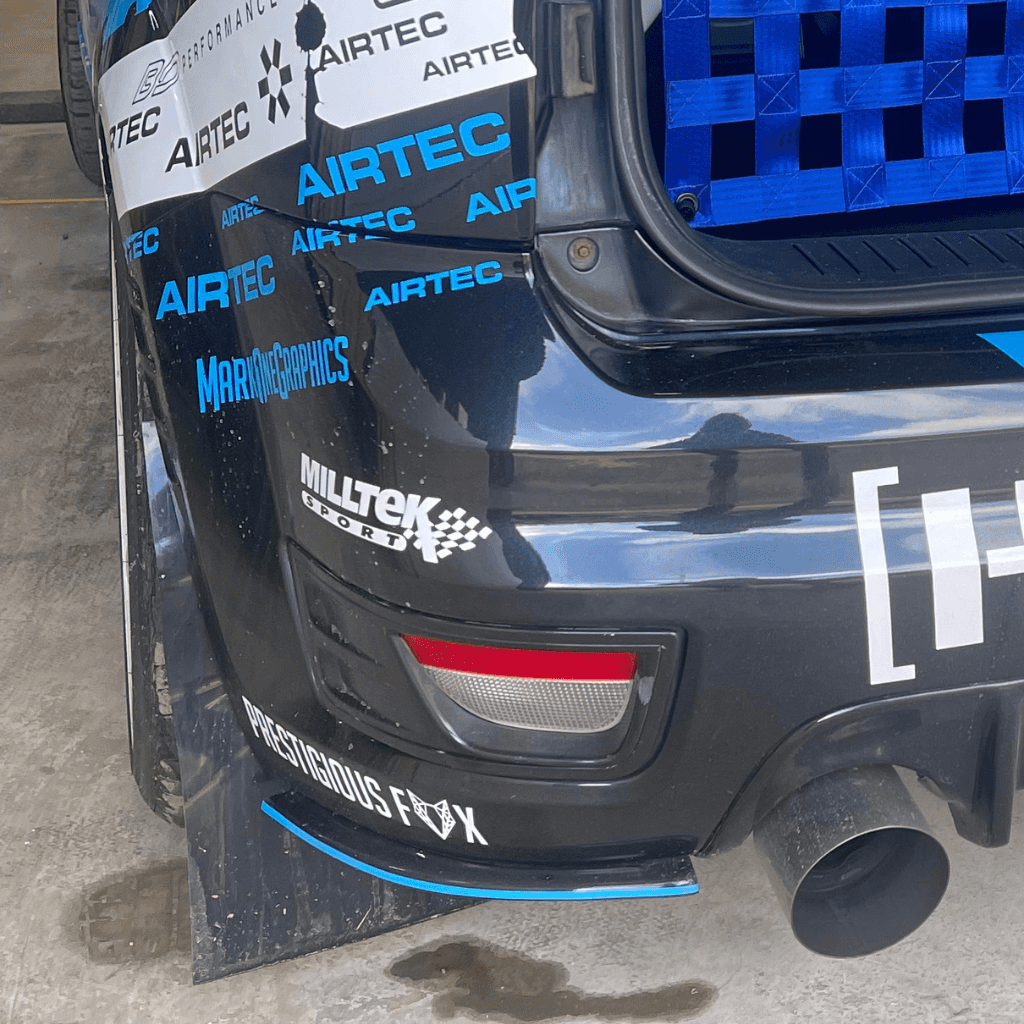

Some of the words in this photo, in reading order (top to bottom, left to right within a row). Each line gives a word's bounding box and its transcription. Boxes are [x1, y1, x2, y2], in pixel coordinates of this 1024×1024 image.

[319, 11, 448, 68] AIRTEC
[164, 101, 251, 173] AIRTEC
[297, 112, 512, 206] AIRTEC
[155, 254, 276, 321] AIRTEC
[364, 260, 503, 312] AIRTEC
[305, 495, 400, 548] SPORT
[241, 695, 392, 818] PRESTIGIOUS
